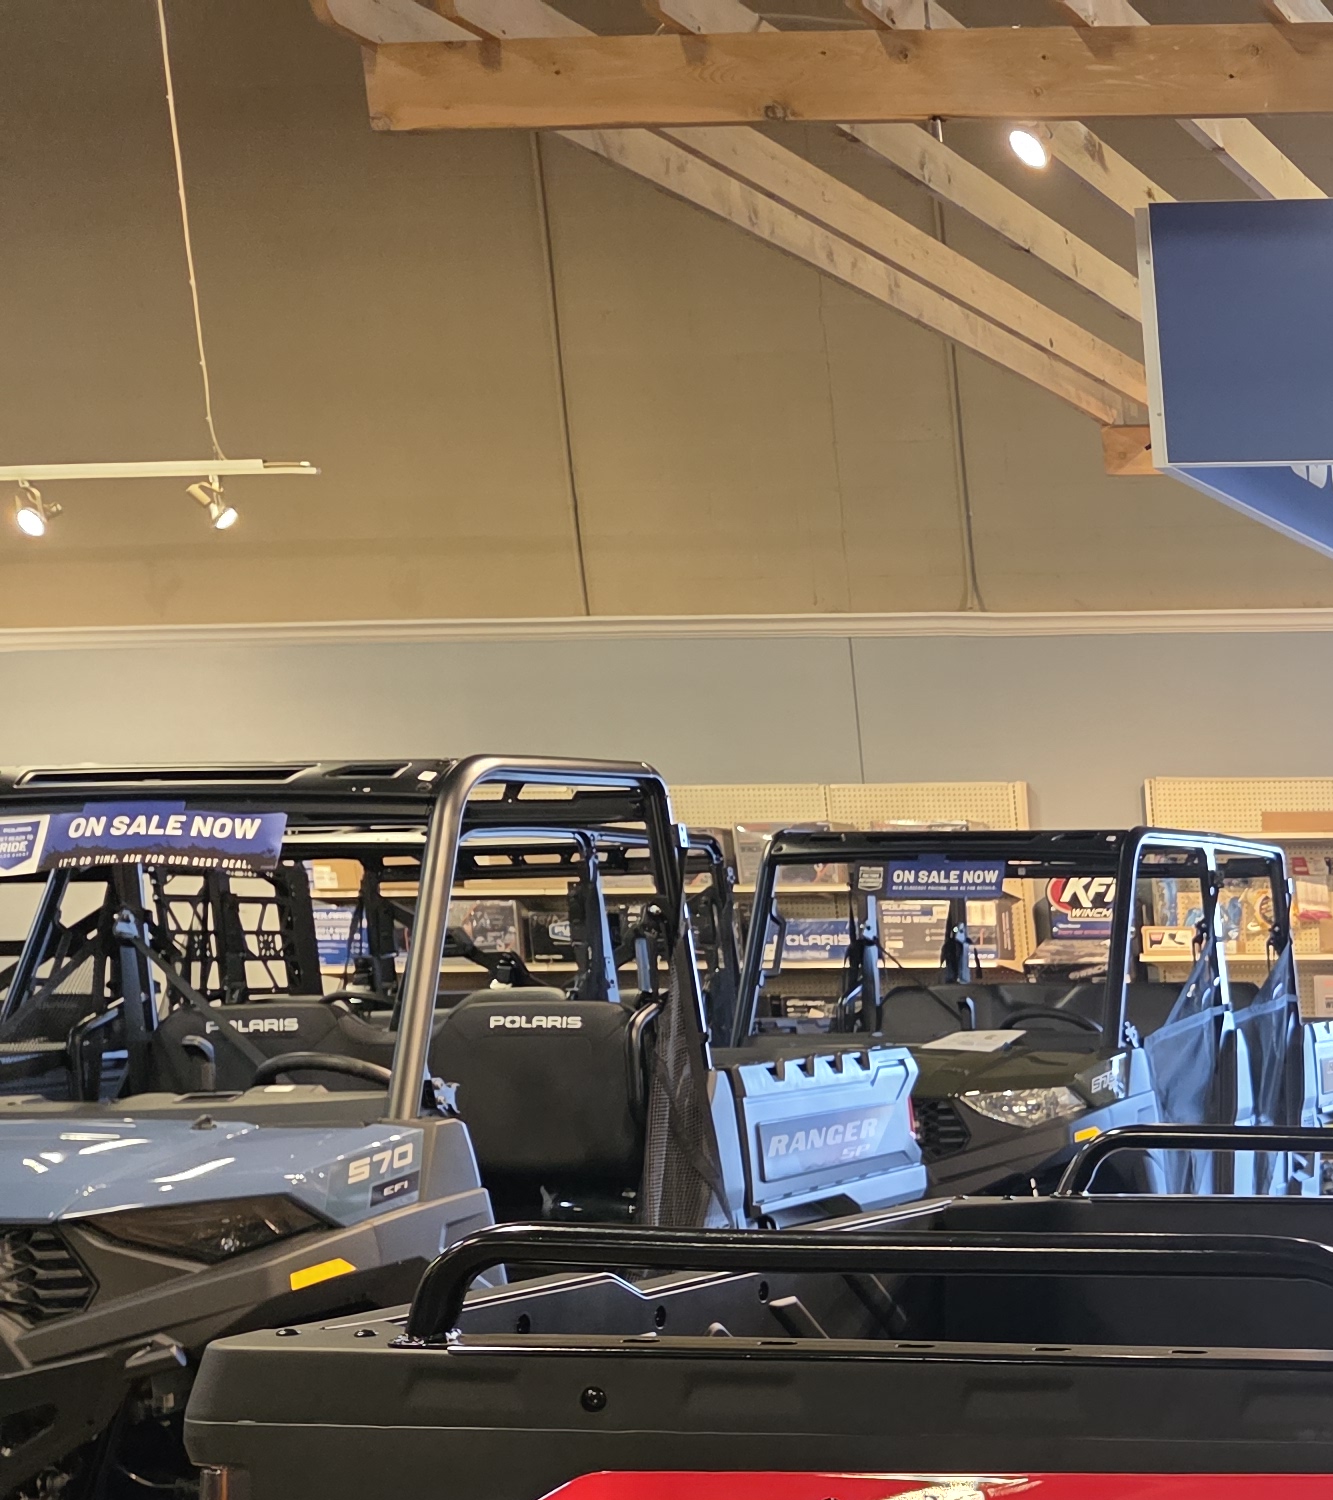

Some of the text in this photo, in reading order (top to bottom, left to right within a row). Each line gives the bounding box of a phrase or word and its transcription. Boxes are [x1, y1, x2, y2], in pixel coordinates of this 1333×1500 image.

[68, 814, 262, 839] ON SALE NOW
[892, 869, 915, 884] ON
[917, 869, 960, 884] SALE
[962, 869, 999, 884] NOW
[774, 934, 851, 946] OLARIS
[489, 1015, 583, 1029] POLARIS
[767, 1117, 879, 1159] RANGER
[840, 1142, 871, 1161] SP
[347, 1142, 415, 1185] 570
[382, 1179, 410, 1198] EFI
